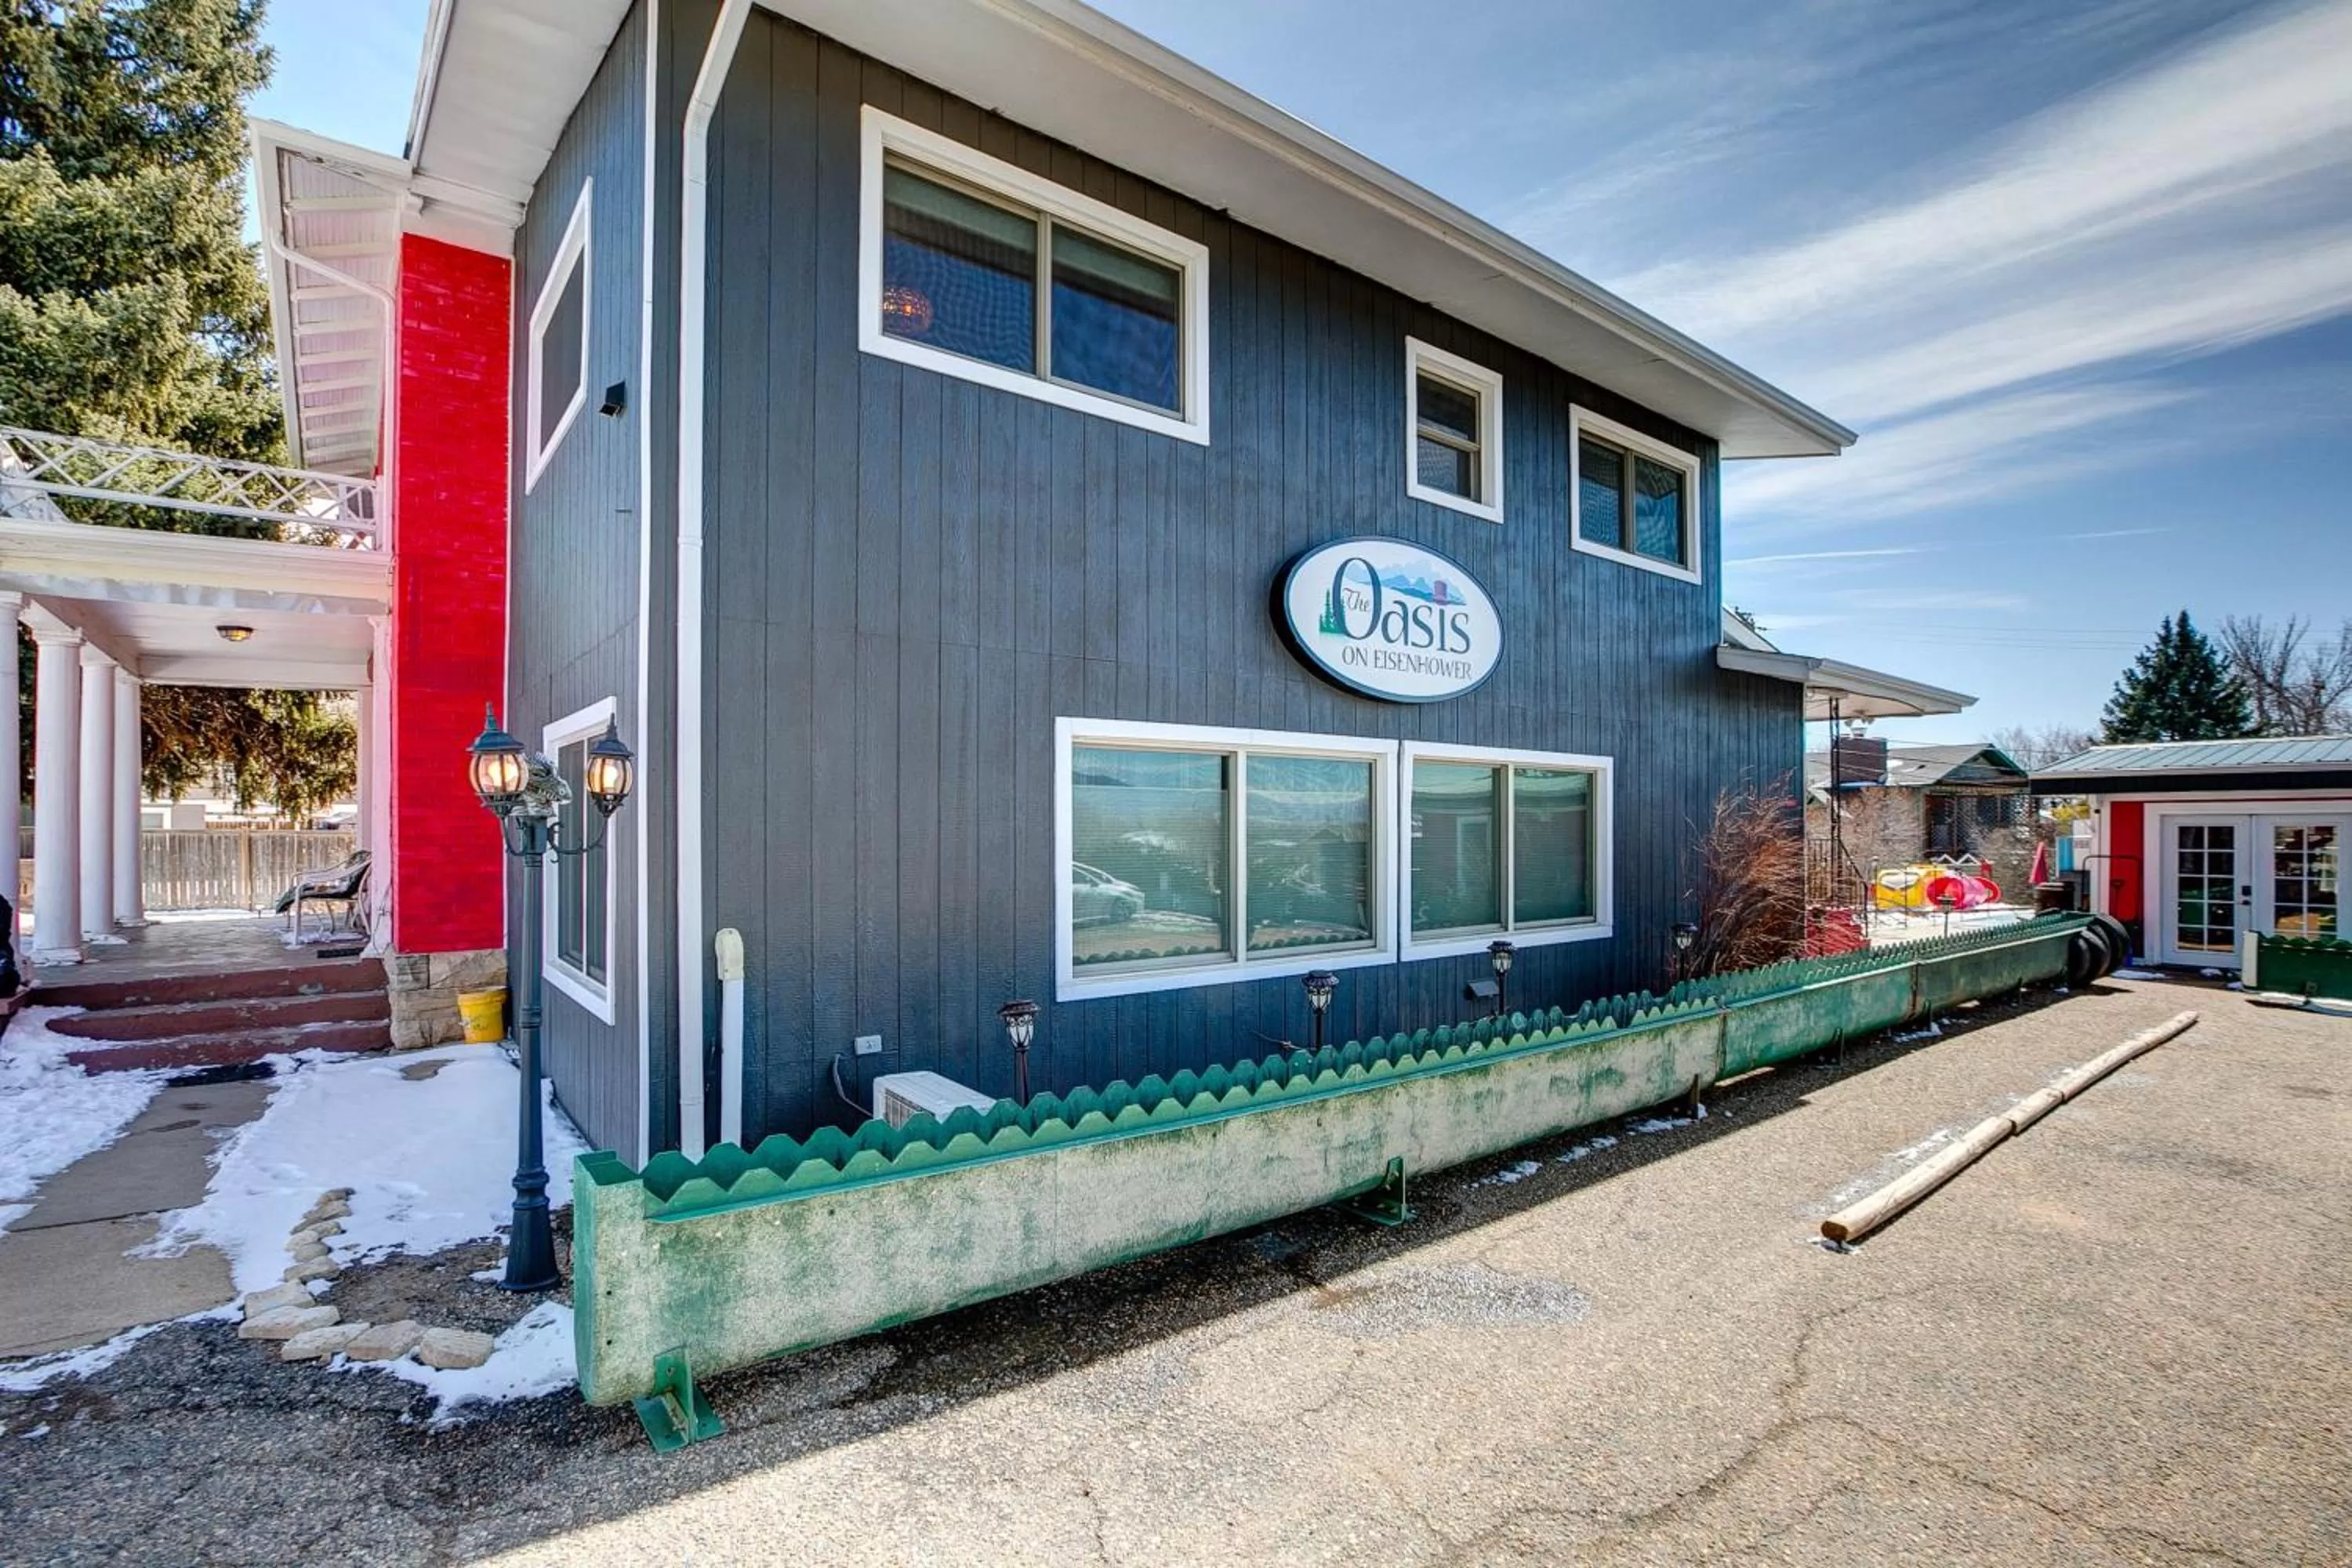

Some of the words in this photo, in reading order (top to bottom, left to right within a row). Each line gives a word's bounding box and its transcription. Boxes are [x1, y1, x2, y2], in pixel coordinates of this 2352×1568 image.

[1332, 557, 1470, 654] Oasis
[1344, 588, 1370, 612] The
[1342, 645, 1368, 667] ON
[1374, 649, 1472, 680] EISENHOWER
